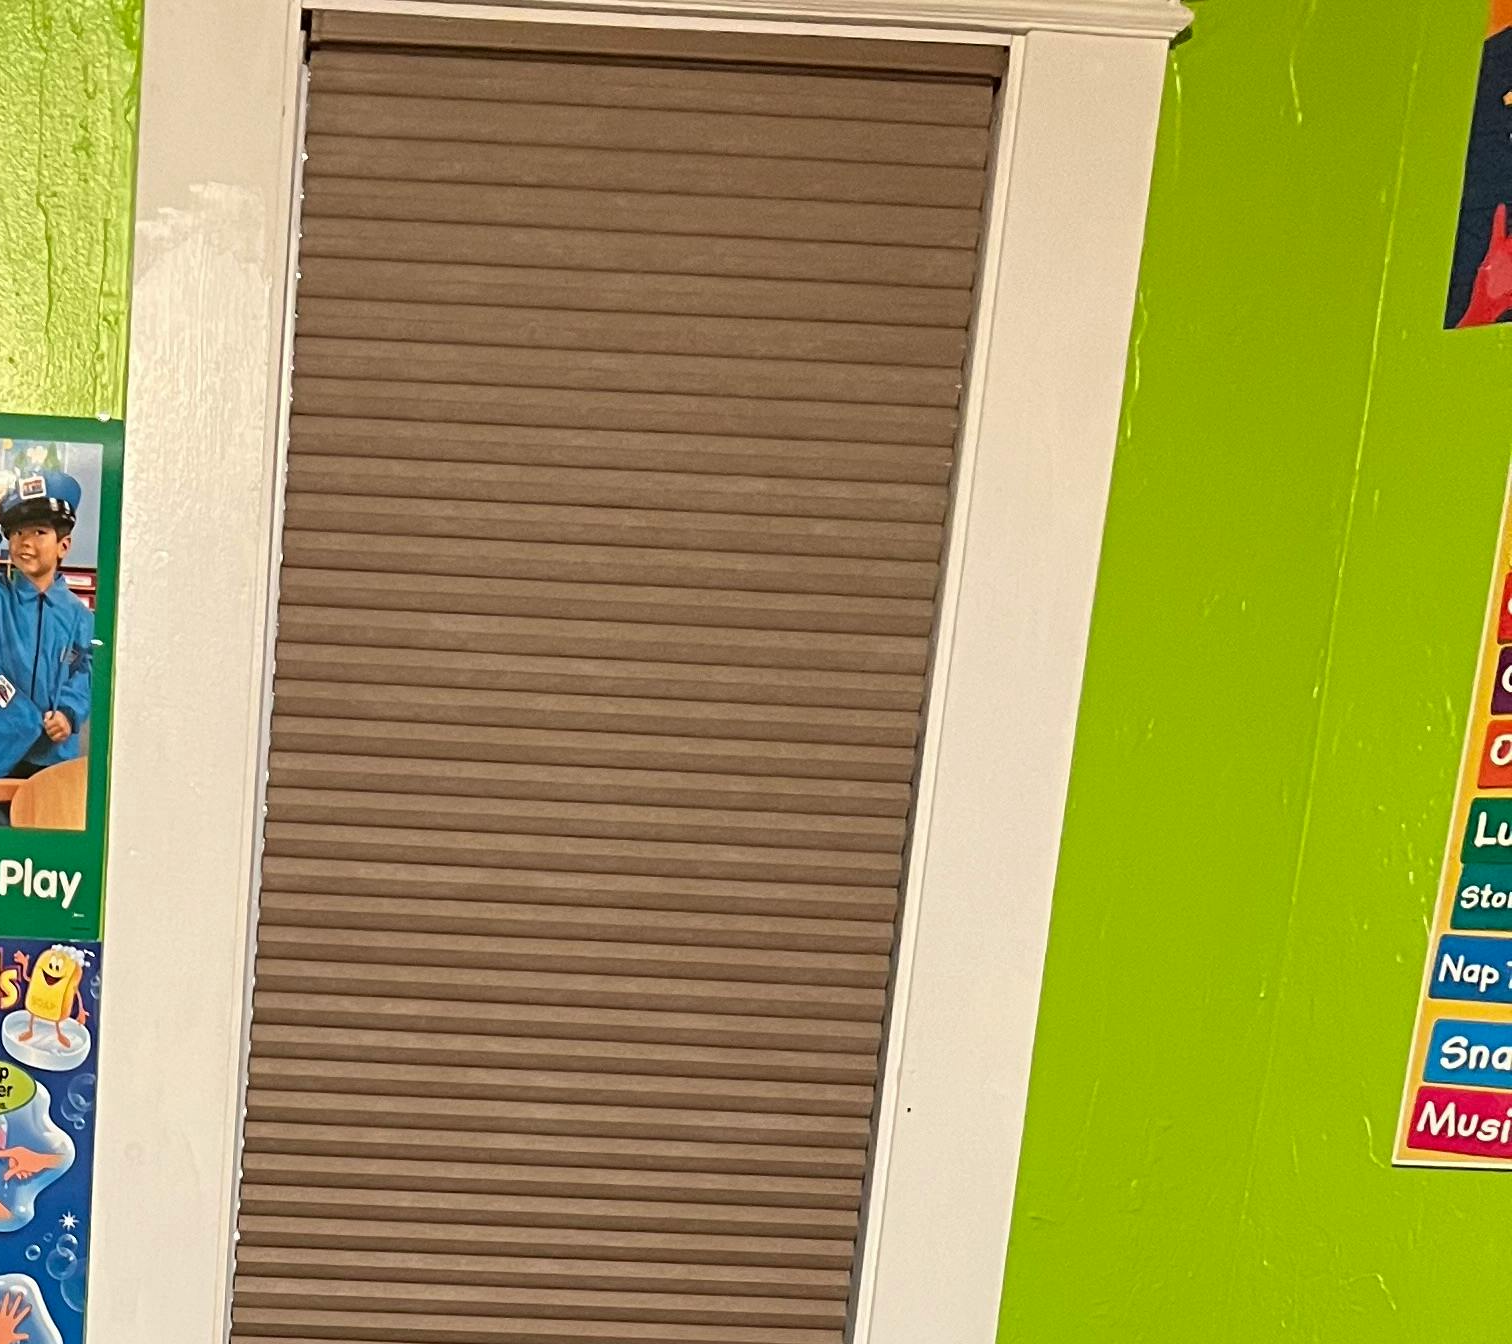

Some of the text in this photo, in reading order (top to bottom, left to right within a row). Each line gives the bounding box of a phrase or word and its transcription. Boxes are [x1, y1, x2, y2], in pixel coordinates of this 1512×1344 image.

[1438, 953, 1500, 992] Nap
[1439, 1035, 1512, 1070] Sna
[1416, 1099, 1512, 1145] Musi
